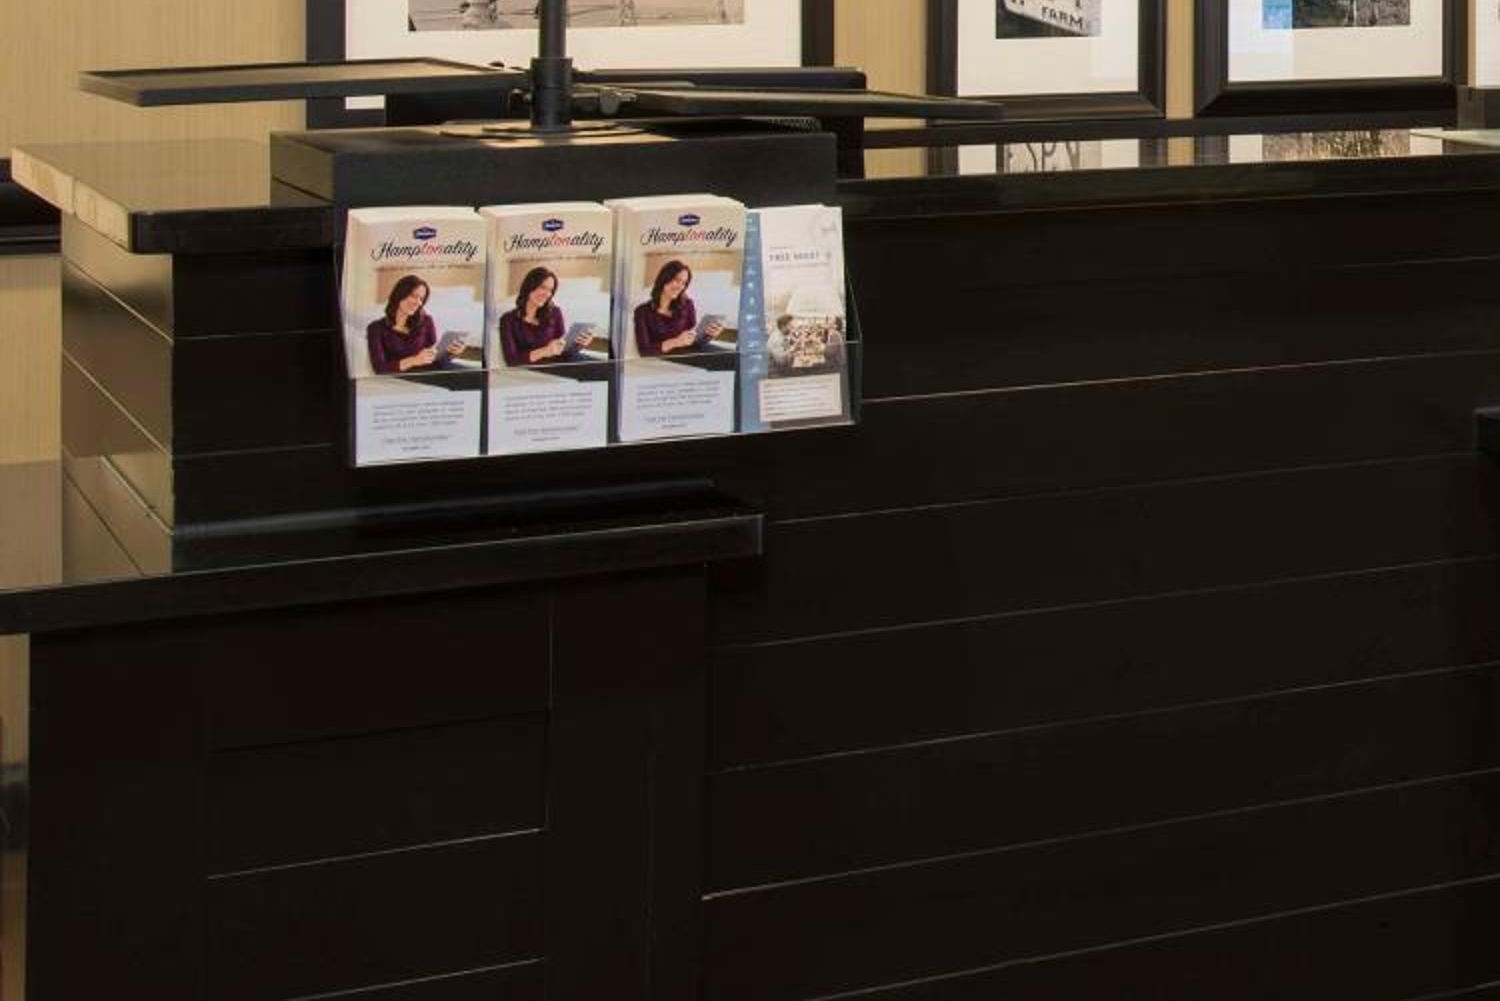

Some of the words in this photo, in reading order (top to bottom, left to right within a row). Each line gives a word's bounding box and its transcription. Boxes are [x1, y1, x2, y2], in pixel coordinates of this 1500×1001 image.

[1041, 5, 1084, 30] FARM
[504, 231, 604, 252] Hamptonality
[640, 227, 738, 247] Hamptonality
[371, 240, 479, 262] Hamptonality
